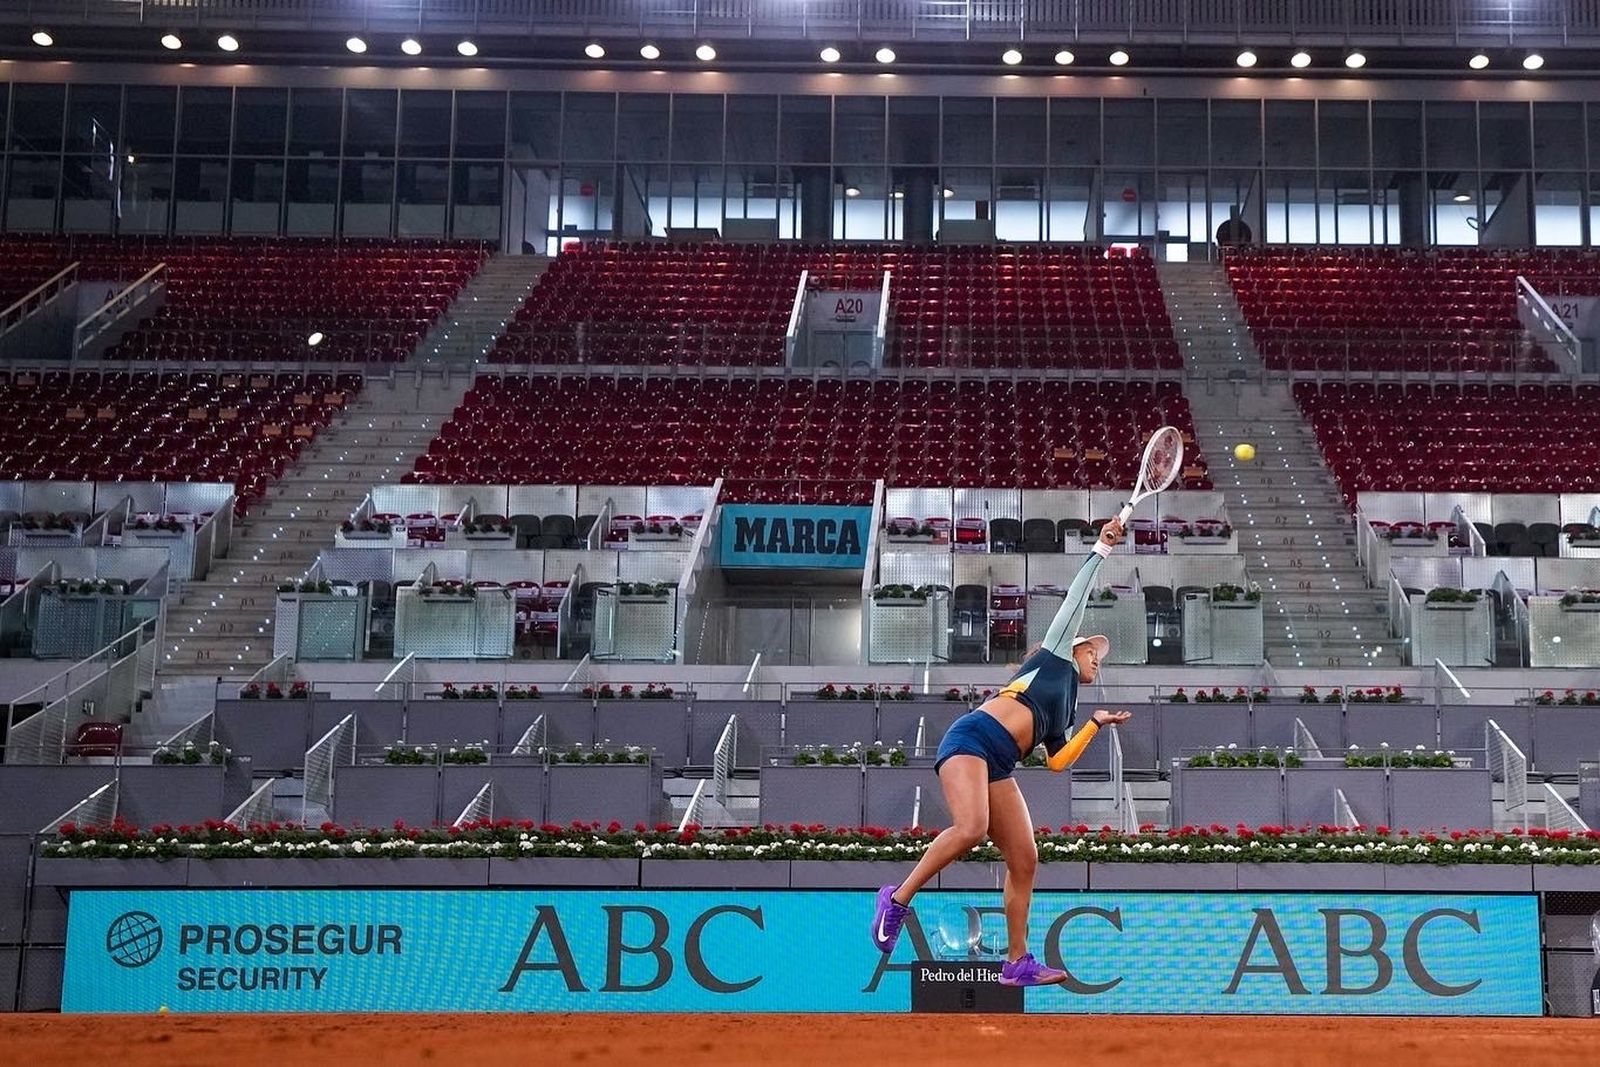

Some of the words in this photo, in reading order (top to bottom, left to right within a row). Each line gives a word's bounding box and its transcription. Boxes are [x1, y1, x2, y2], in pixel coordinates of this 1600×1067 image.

[834, 298, 864, 314] A20
[1552, 303, 1578, 318] A21
[734, 517, 861, 554] MARCA
[179, 925, 402, 955] PROSEGUR
[498, 904, 765, 994] ABC
[1221, 908, 1482, 997] ABC
[177, 967, 328, 991] SECURITY
[921, 968, 955, 982] Pedro
[957, 968, 974, 982] del
[977, 968, 1003, 982] Hier
